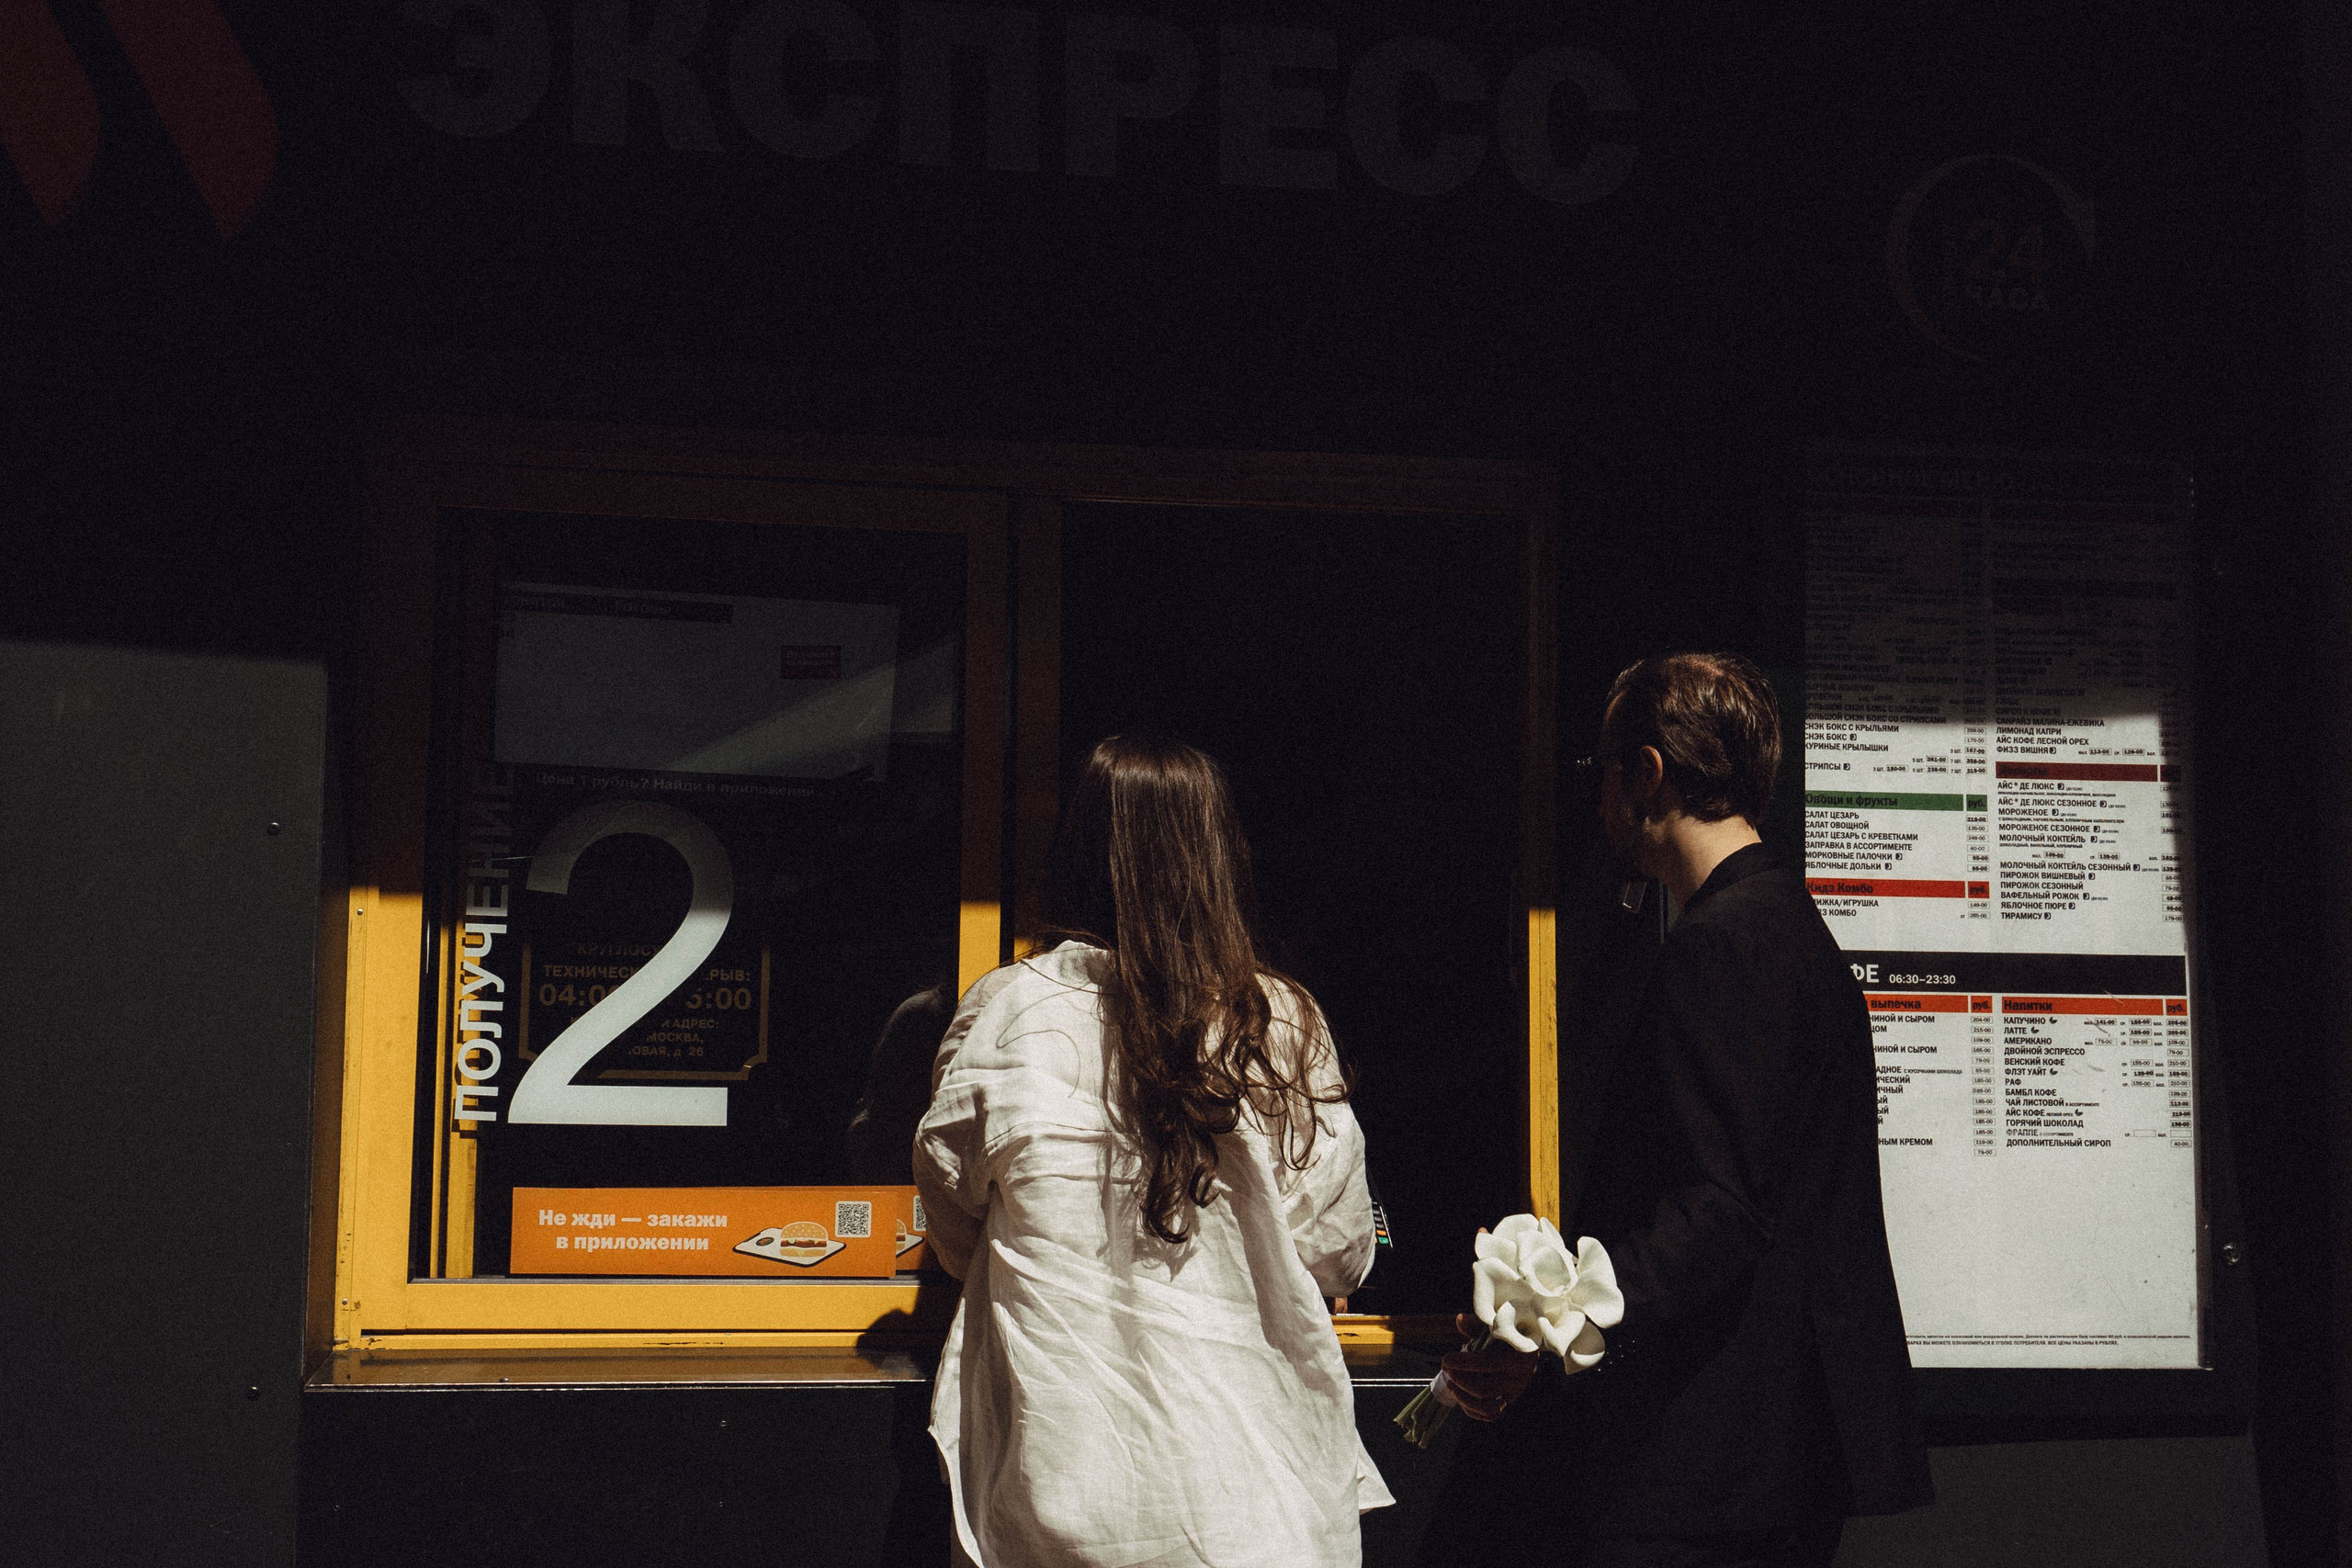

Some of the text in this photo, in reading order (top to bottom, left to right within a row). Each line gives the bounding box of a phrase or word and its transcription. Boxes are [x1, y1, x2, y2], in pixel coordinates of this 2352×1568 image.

[396, 0, 1640, 206] ЭКСПРЕСС
[1964, 219, 2053, 285] 24
[1805, 722, 1825, 730] СНЭК
[1826, 723, 1848, 731] БОКС
[1855, 724, 1899, 733] КРЫЛЬЯМИ
[2032, 718, 2105, 727] МАЛИНА-ЕЖЕВИКА
[1805, 732, 1848, 741] СНЭК БОКС
[1996, 728, 2062, 736] ЛИМОНАД КАПРИ
[1996, 736, 2012, 744] АЙС
[2036, 736, 2067, 745] ЛЕСНОЙ
[2069, 738, 2089, 746] ОРЕХ
[1805, 742, 1841, 750] КУРИНЫЕ
[1842, 743, 1889, 751] КРЫЛЫШКИ
[1996, 746, 2049, 754] ФИЗЗ ВИШНЯ
[1805, 761, 1841, 771] СТРИПСЫ
[653, 777, 702, 795] Найди
[1997, 780, 2013, 789] АЙС
[2019, 782, 2030, 790] ДЕ
[1806, 794, 1844, 806] Овощи
[1846, 796, 1853, 806] и
[1856, 795, 1898, 807] фрукты
[1997, 796, 2098, 807] АЙС ДЕ ЛЮКС СЕЗОННОЕ
[1805, 810, 1860, 819] САЛАТ ЦЕЗАРЬ
[1998, 808, 2049, 817] МОРОЖЕНОЕ
[1805, 820, 1870, 830] САЛАТ ОВОЩНОЙ
[1998, 823, 2049, 831] МОРОЖЕНОЕ
[1805, 830, 1829, 839] САЛАТ
[1830, 831, 1860, 840] ЦЕЗАРЬ
[1869, 832, 1918, 841] КРЕВЕТКАМИ
[1999, 833, 2086, 843] МОЛОЧНЫЙ КОКТЕЙЛЬ
[1805, 840, 1845, 850] ЗАПРАВКА
[1847, 841, 1852, 850] В
[1853, 842, 1913, 852] АССОРТИМЕНТЕ
[1805, 852, 1893, 861] МОРКОВНЫЕ ПАЛОЧКИ
[1805, 861, 1882, 871] ЯБЛОЧНЫЕ ДОЛЬКИ
[2000, 861, 2046, 870] МОЛОЧНЫЙ
[2048, 862, 2086, 871] КОКТЕЙЛЬ
[2087, 863, 2131, 871] СЕЗОННЫЙ
[2000, 872, 2086, 880] ПИРОЖОК ВИШНЕВЫЙ
[1806, 882, 1835, 895] Кидз
[1838, 883, 1874, 894] Комбо
[2000, 881, 2084, 890] ПИРОЖОК СЕЗОННЫЙ
[2000, 890, 2051, 899] ВАФЕЛЬНЫЙ
[2052, 892, 2079, 900] РОЖОК
[1814, 898, 1879, 908] ИЖКА/ИГРУШКА
[2001, 901, 2067, 910] ЯБЛОЧНОЕ ПЮРЕ
[1829, 908, 1857, 917] КОМБО
[453, 764, 514, 1123] ПОЛУЧЕНИЕ
[507, 800, 736, 1127] 2
[542, 964, 643, 980] ТЕХНИЧЕСК
[1850, 963, 1956, 985] ФЕ 06:30–23:30
[538, 984, 622, 1007] 04:0
[1871, 1000, 1991, 1011] выпечка руб.
[2004, 999, 2052, 1010] Напитки
[1870, 1013, 1896, 1022] НИНОЙ
[1905, 1015, 1935, 1023] СЫРОМ
[2004, 1017, 2046, 1025] КАПУЧИНО
[2004, 1037, 2052, 1045] АМЕРИКАНО
[628, 1044, 671, 1057] ОВАЯ,
[1907, 1045, 1938, 1054] СЫРОМ
[2004, 1046, 2042, 1055] ДВОЙНОЙ
[2043, 1047, 2086, 1055] ЭСПРЕССО
[2004, 1056, 2041, 1066] ВЕНСКИЙ
[2042, 1058, 2065, 1066] КОФЕ
[1876, 1066, 1902, 1075] АДНОЕ
[2004, 1066, 2047, 1076] ФЛЭТ УАЙТ
[1876, 1075, 1911, 1084] ИЧЕСКИЙ
[2005, 1077, 2022, 1086] РАФ
[2005, 1089, 2057, 1097] БАМБЛ КОФЕ
[2006, 1097, 2064, 1107] ЧАЙ ЛИСТОВОЙ
[2006, 1108, 2045, 1117] АЙС КОФЕ
[2006, 1118, 2084, 1128] ГОРЯЧИЙ ШОКОЛАД
[1900, 1138, 1933, 1146] КРЕМОМ
[2006, 1138, 2083, 1147] ДОПОЛНИТЕЛЬНЫЙ
[2084, 1139, 2111, 1147] СИРОП
[538, 1209, 568, 1226] Не
[571, 1212, 616, 1230] жди
[647, 1213, 728, 1228] закажи
[556, 1235, 709, 1254] в приложении
